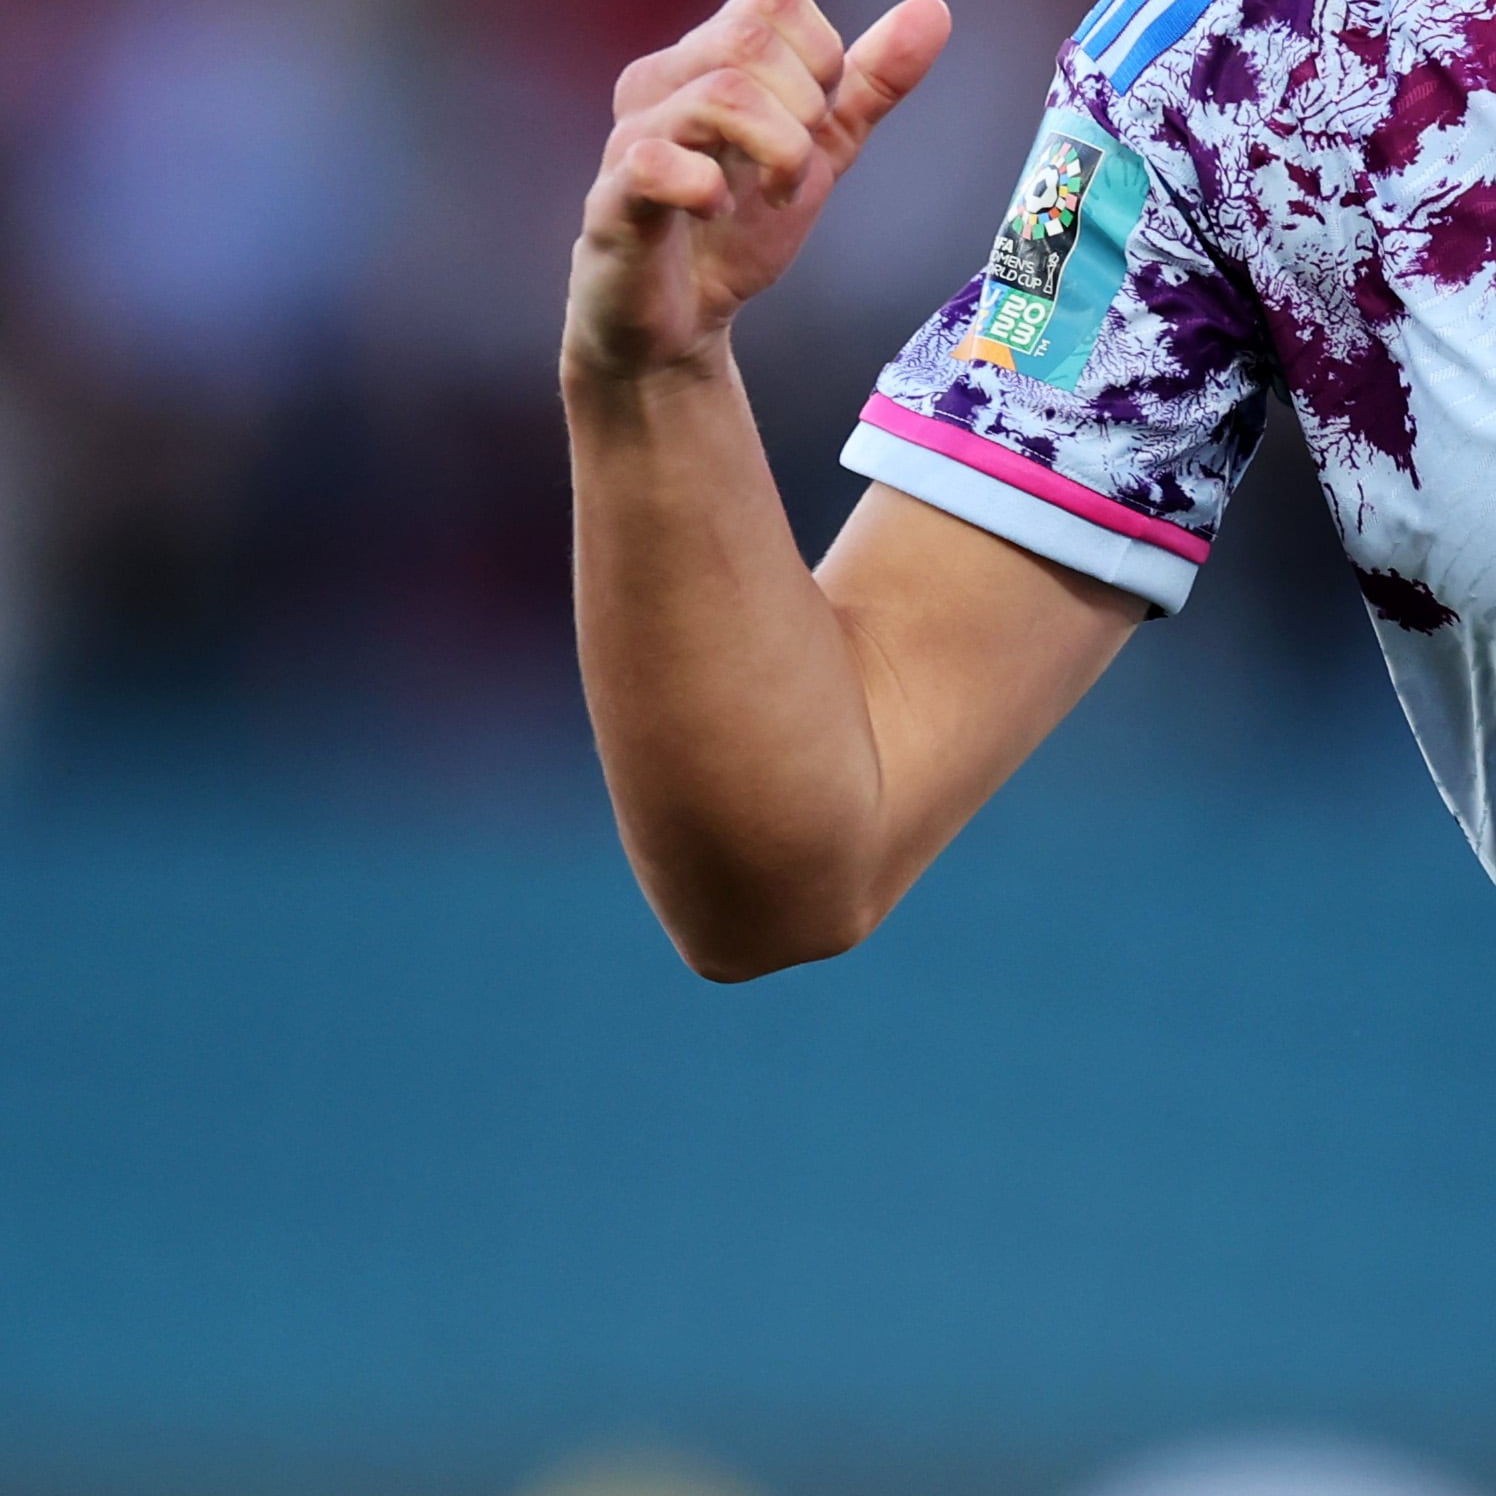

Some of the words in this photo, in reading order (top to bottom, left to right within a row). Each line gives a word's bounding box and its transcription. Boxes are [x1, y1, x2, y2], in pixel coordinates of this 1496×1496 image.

[989, 249, 1036, 274] OMEN'S
[1017, 273, 1043, 290] CUP
[1001, 294, 1047, 325] 20
[989, 314, 1036, 346] 23
